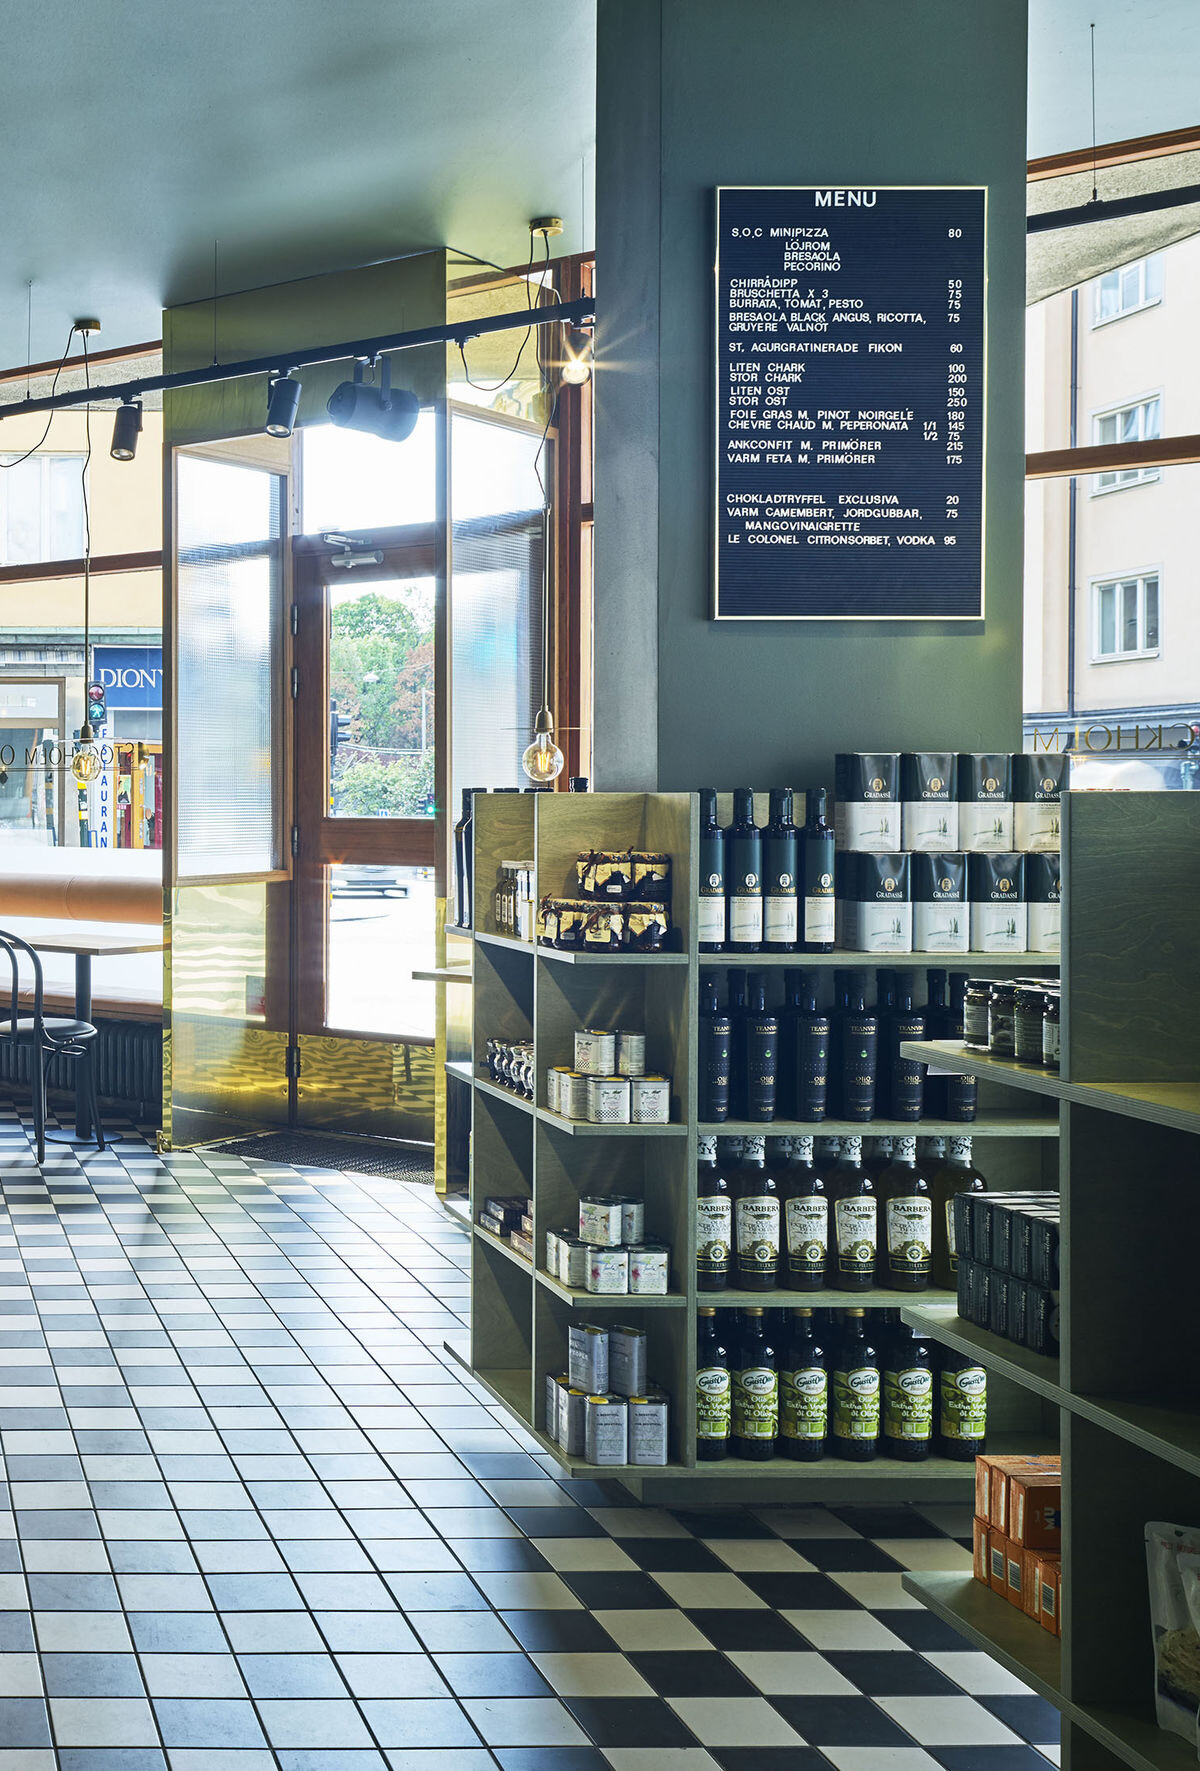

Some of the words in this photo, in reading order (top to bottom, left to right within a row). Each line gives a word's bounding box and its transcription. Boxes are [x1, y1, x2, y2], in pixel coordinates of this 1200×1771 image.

[814, 191, 877, 207] MENU
[770, 228, 829, 237] MINIPIZZA
[948, 229, 962, 238] 80
[785, 239, 830, 251] LÖJROM
[783, 252, 841, 261] BRESAOLA
[783, 262, 841, 271] PECORINO
[948, 280, 962, 289] 50
[730, 289, 800, 298] BRUSCHETTA
[808, 290, 815, 298] X
[822, 290, 829, 298] 3
[948, 290, 962, 299] 75
[729, 300, 781, 310] BURRATA,
[784, 300, 826, 310] TOMAT,
[828, 300, 864, 309] PESTO
[948, 300, 961, 309] 75
[729, 313, 787, 322] BRESAOLA
[790, 313, 826, 322] BLACK
[832, 313, 872, 324] ANGUS,
[876, 313, 927, 324] RICOTTA,
[947, 313, 960, 323] 75
[728, 323, 778, 332] GRUYERE
[787, 320, 829, 332] VALNÖT
[728, 343, 745, 353] ST.
[751, 343, 859, 352] AGURGRATINERADE
[868, 343, 902, 352] FIKON
[950, 344, 963, 353] 60
[729, 363, 761, 372] LITEN
[767, 363, 806, 372] CHARK
[947, 364, 965, 373] 100
[729, 373, 758, 382] STOR
[765, 373, 802, 382] CHARK
[947, 374, 967, 383] 200
[730, 387, 762, 396] LITEN
[767, 387, 790, 396] OST
[947, 388, 965, 397] 150
[729, 397, 759, 406] STOR
[765, 397, 787, 406] OST
[947, 398, 968, 407] 250
[730, 411, 757, 419] FOIE
[762, 411, 793, 419] GRAS
[797, 411, 810, 420] M.
[817, 411, 850, 419] PINOT
[947, 411, 965, 421] 180
[728, 421, 771, 430] CHEVRE
[777, 421, 816, 430] CHAUD
[822, 421, 835, 431] M.
[840, 421, 909, 430] PEPERONATA
[923, 422, 937, 431] 1/1
[947, 422, 965, 431] 145
[923, 432, 939, 441] 1/2
[947, 432, 960, 441] 75
[728, 441, 793, 450] ANKCONFIT
[801, 441, 813, 451] M.
[822, 438, 882, 451] PRIMÖRER
[946, 442, 963, 451] 215
[727, 454, 760, 463] VARM
[766, 454, 792, 463] FETA
[798, 454, 811, 464] M.
[816, 451, 876, 464] PRIMÖRER
[946, 455, 962, 464] 175
[726, 494, 826, 504] CHOKLADTRYFFEL
[838, 495, 899, 504] EXCLUSIVA
[946, 496, 960, 505] 20
[727, 508, 759, 517] VARM
[765, 508, 835, 519] CAMEMBERT,
[843, 509, 923, 519] JORDGUBBAR,
[946, 509, 958, 519] 75
[745, 522, 861, 531] MANGOVINAIGRETTE
[728, 535, 740, 544] LE
[748, 535, 799, 544] COLONEL
[807, 535, 891, 546] CITRONSORBET,
[896, 536, 935, 545] VODKA
[943, 536, 956, 545] 95
